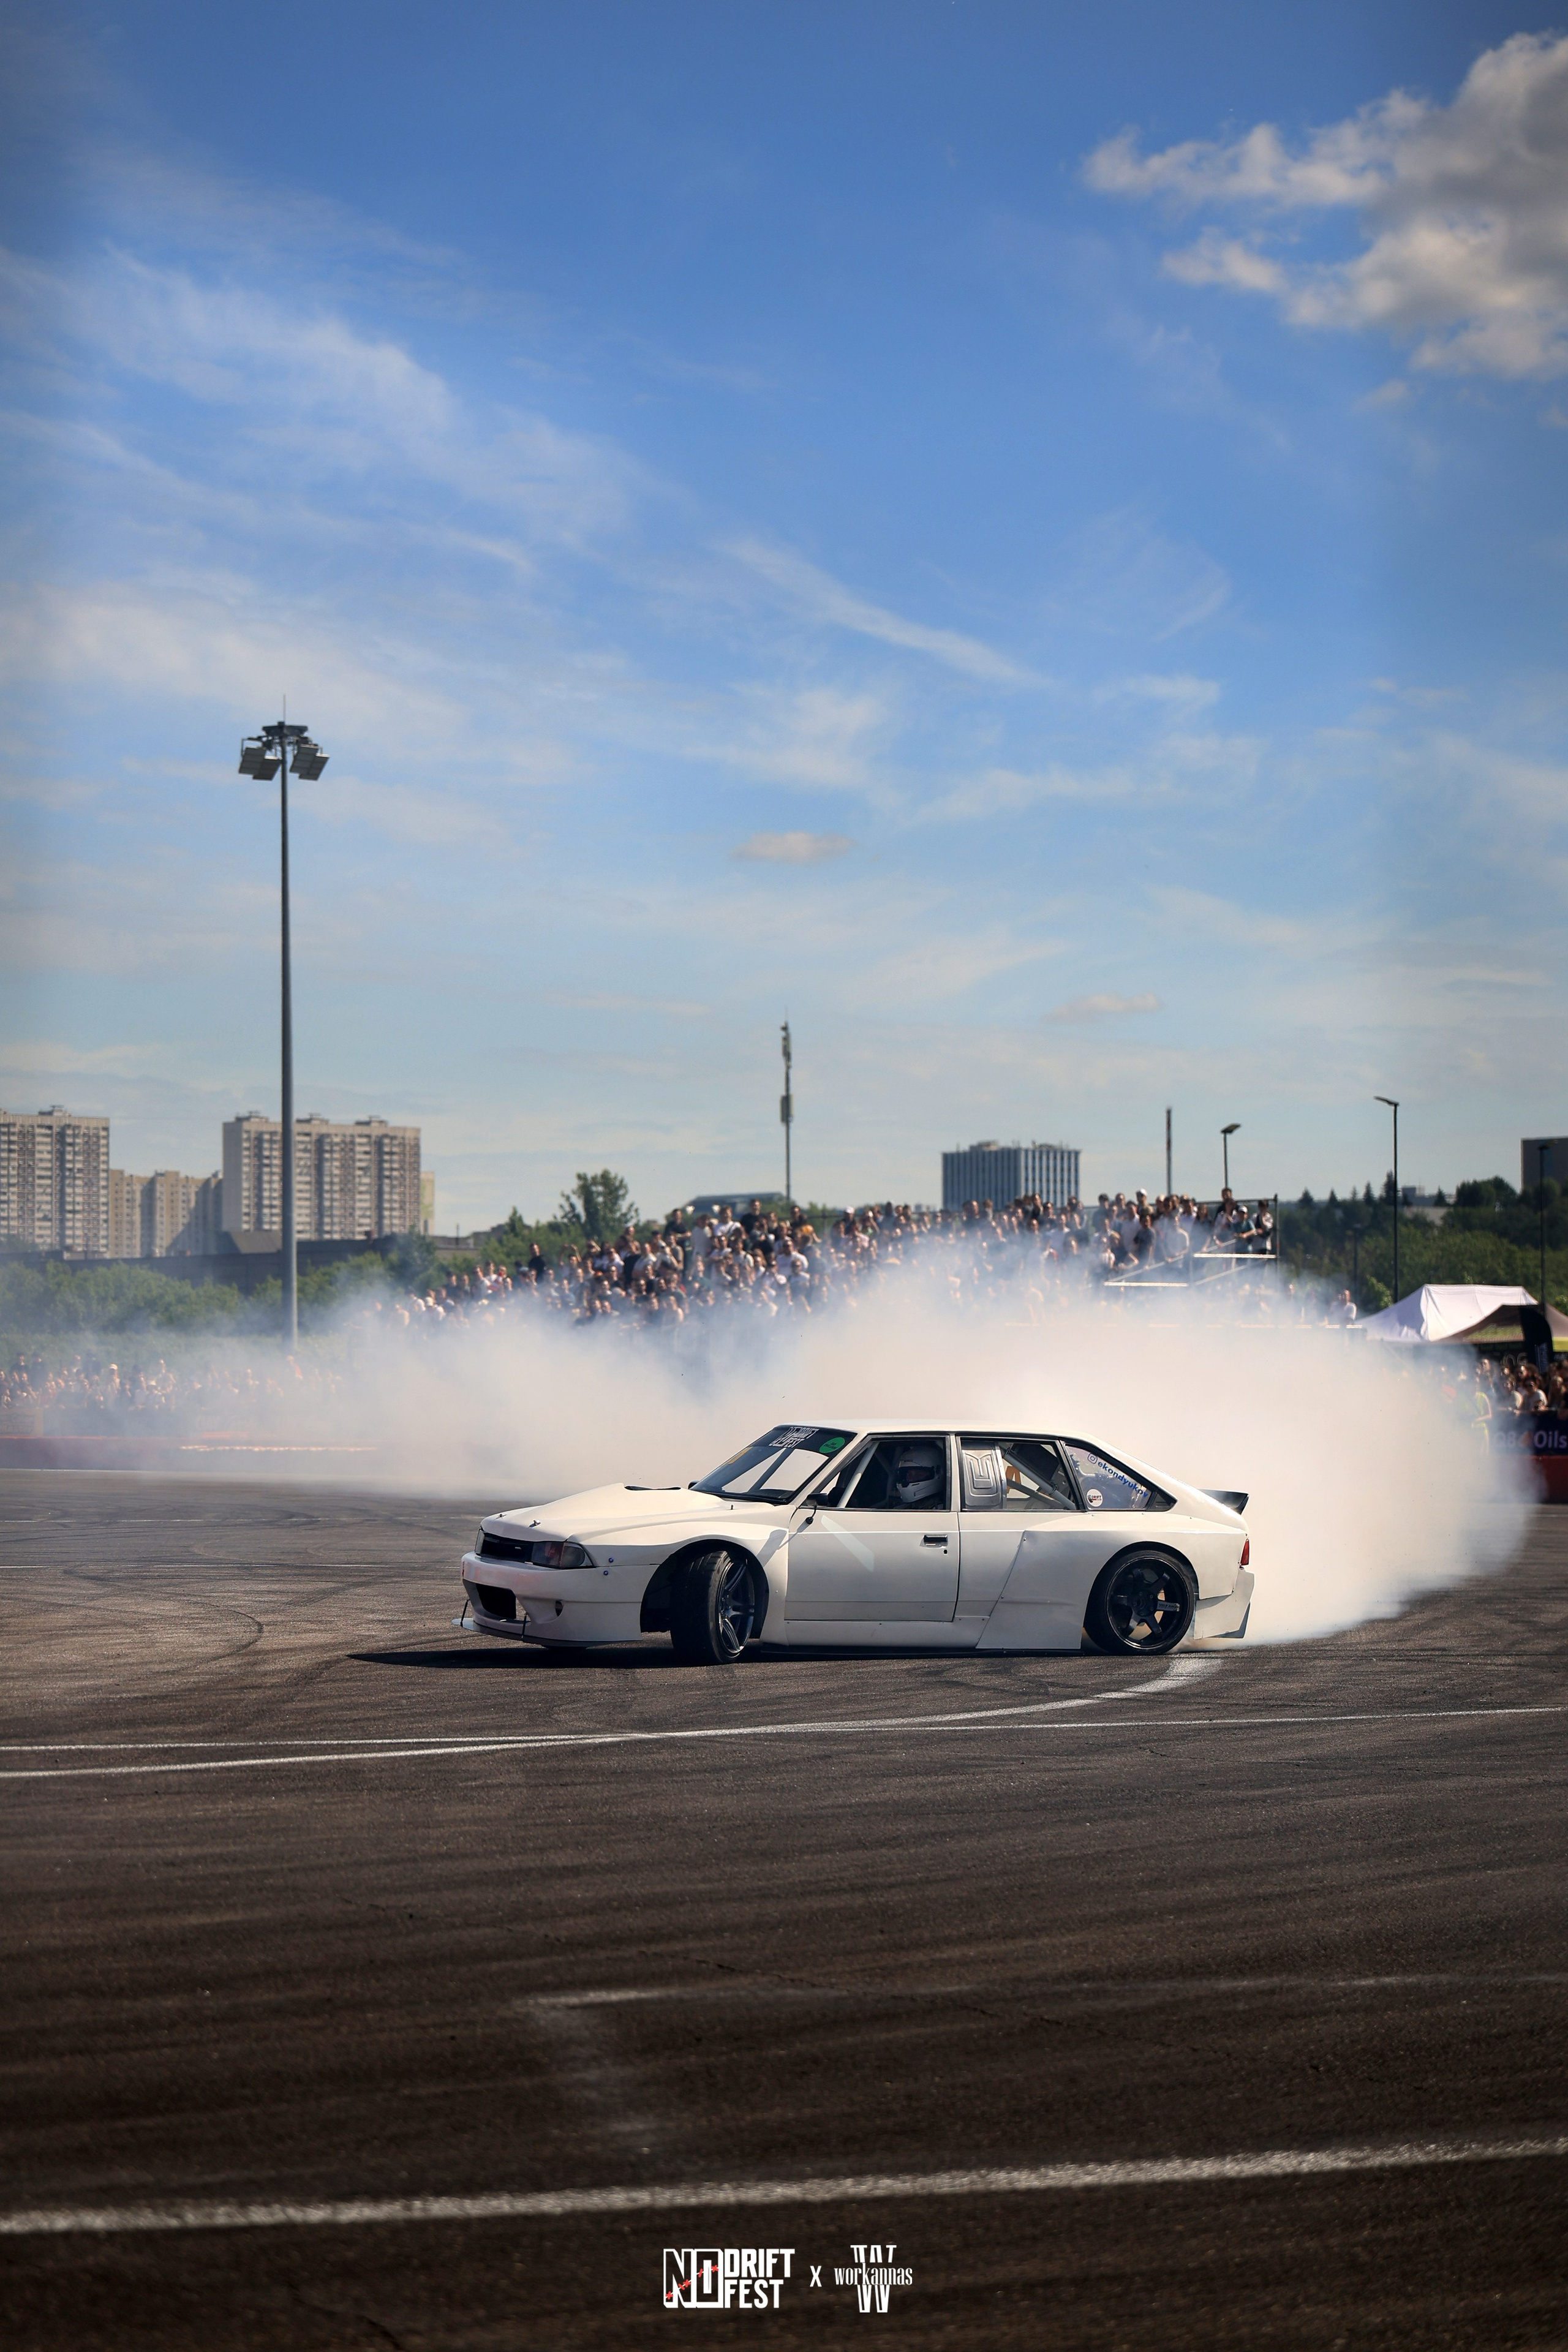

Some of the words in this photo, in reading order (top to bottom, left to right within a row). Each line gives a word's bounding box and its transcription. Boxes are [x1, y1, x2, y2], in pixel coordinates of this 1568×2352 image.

[783, 1438, 805, 1448] FEST
[1534, 1430, 1567, 1449] Oils
[1098, 1461, 1148, 1498] ekondyukov
